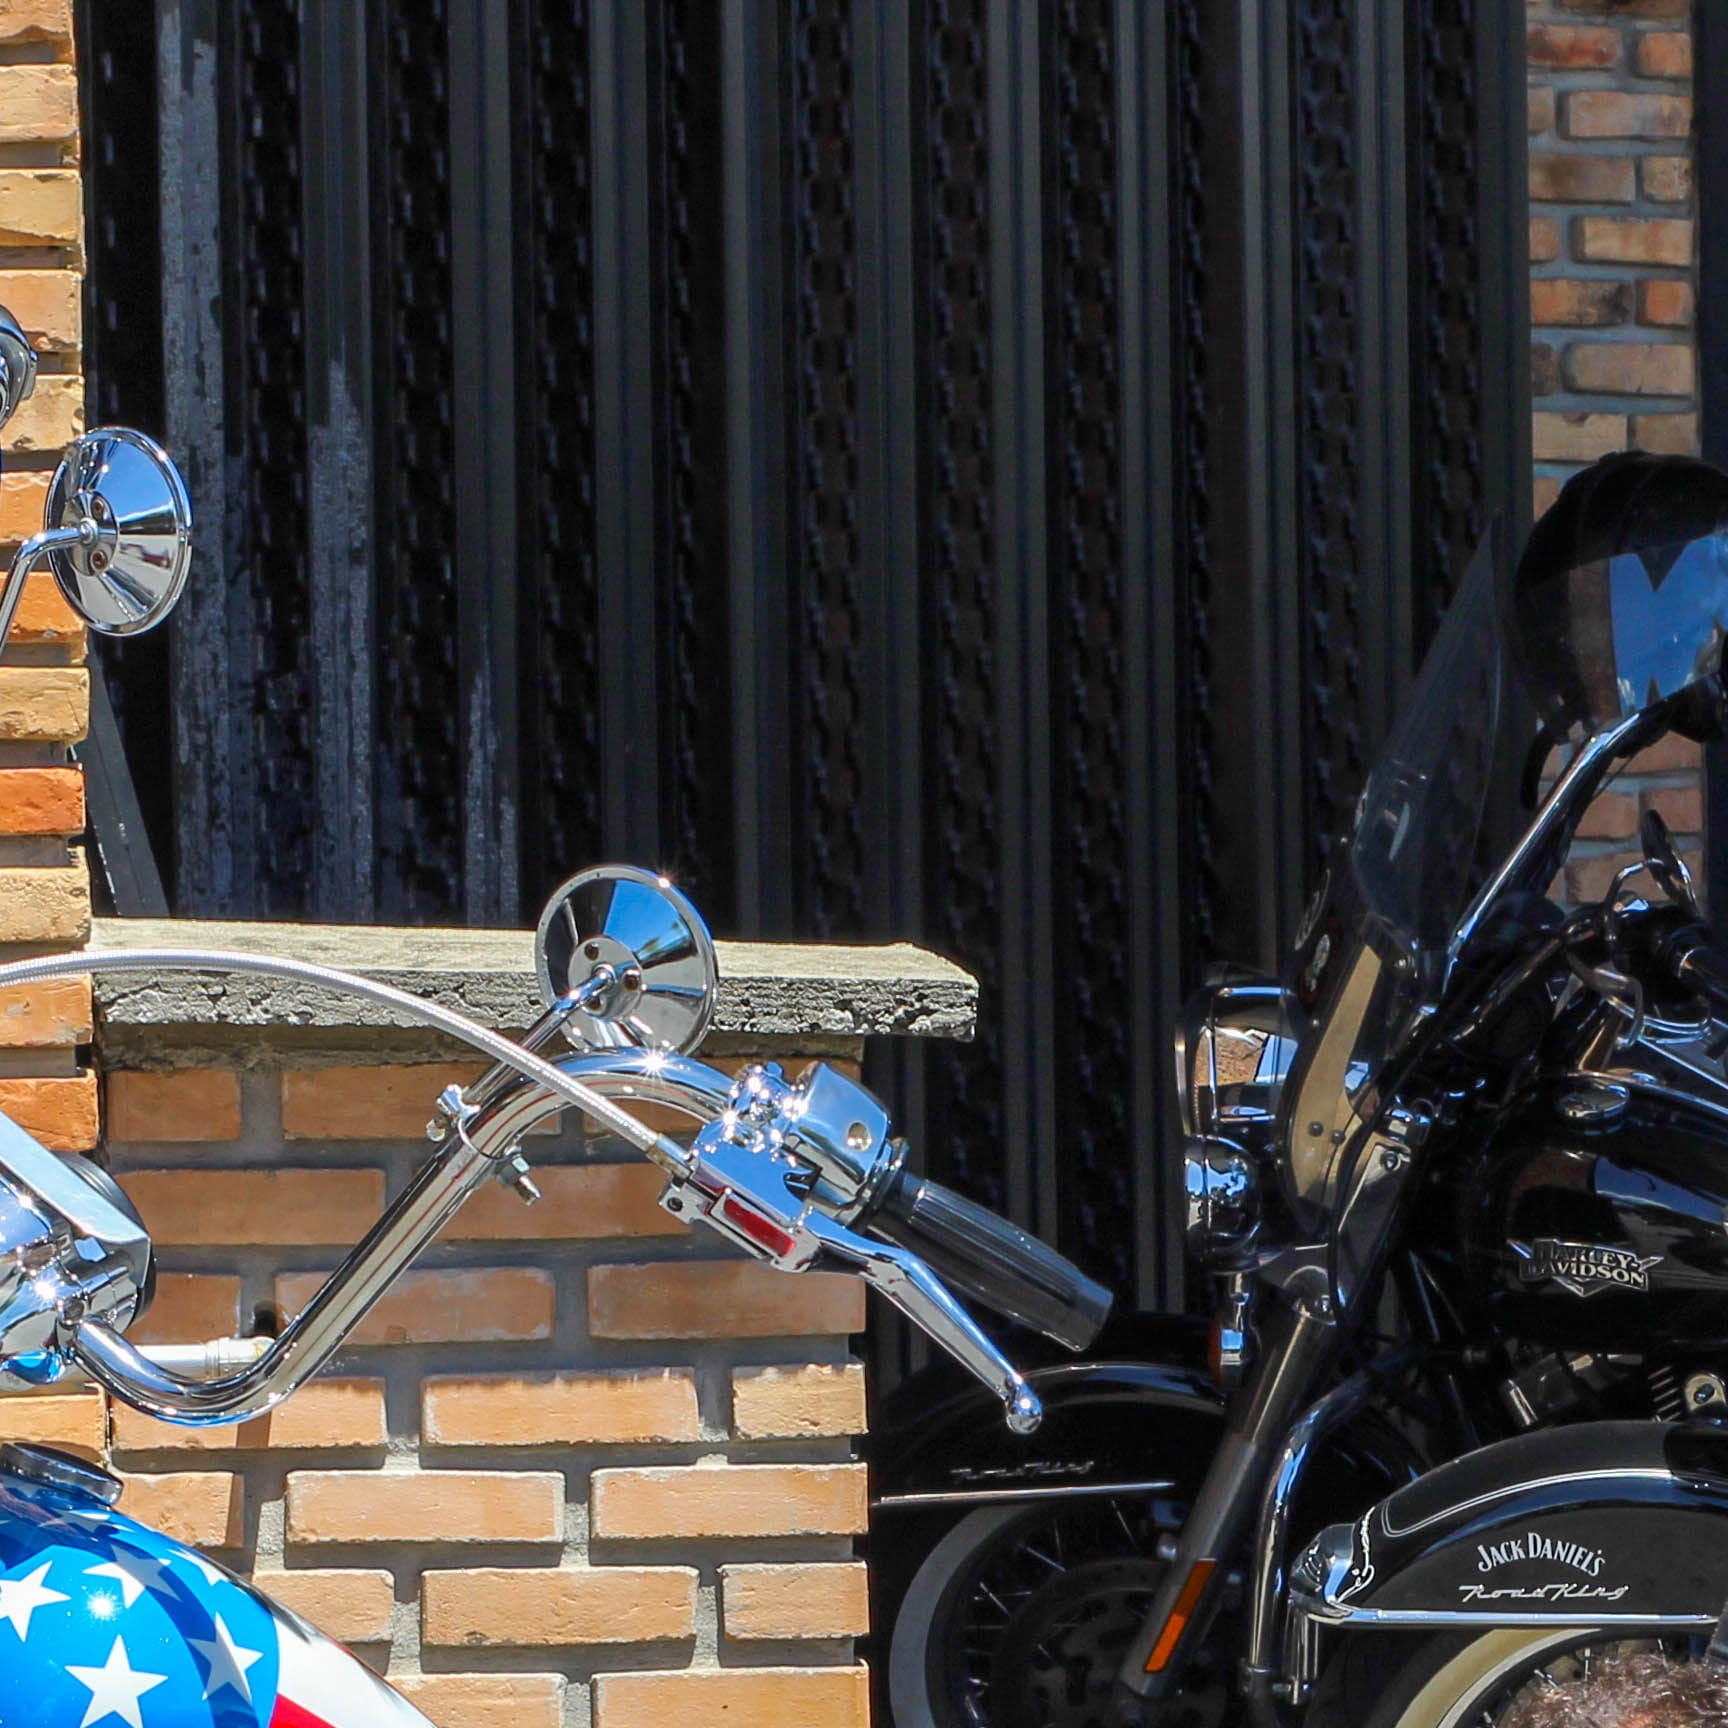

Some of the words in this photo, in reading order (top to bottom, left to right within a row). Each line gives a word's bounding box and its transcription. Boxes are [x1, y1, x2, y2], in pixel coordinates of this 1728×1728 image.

[1478, 1539, 1526, 1572] JACK
[1528, 1532, 1606, 1576] DANIEL'S
[1459, 1584, 1547, 1602] Road
[1546, 1583, 1629, 1601] King
